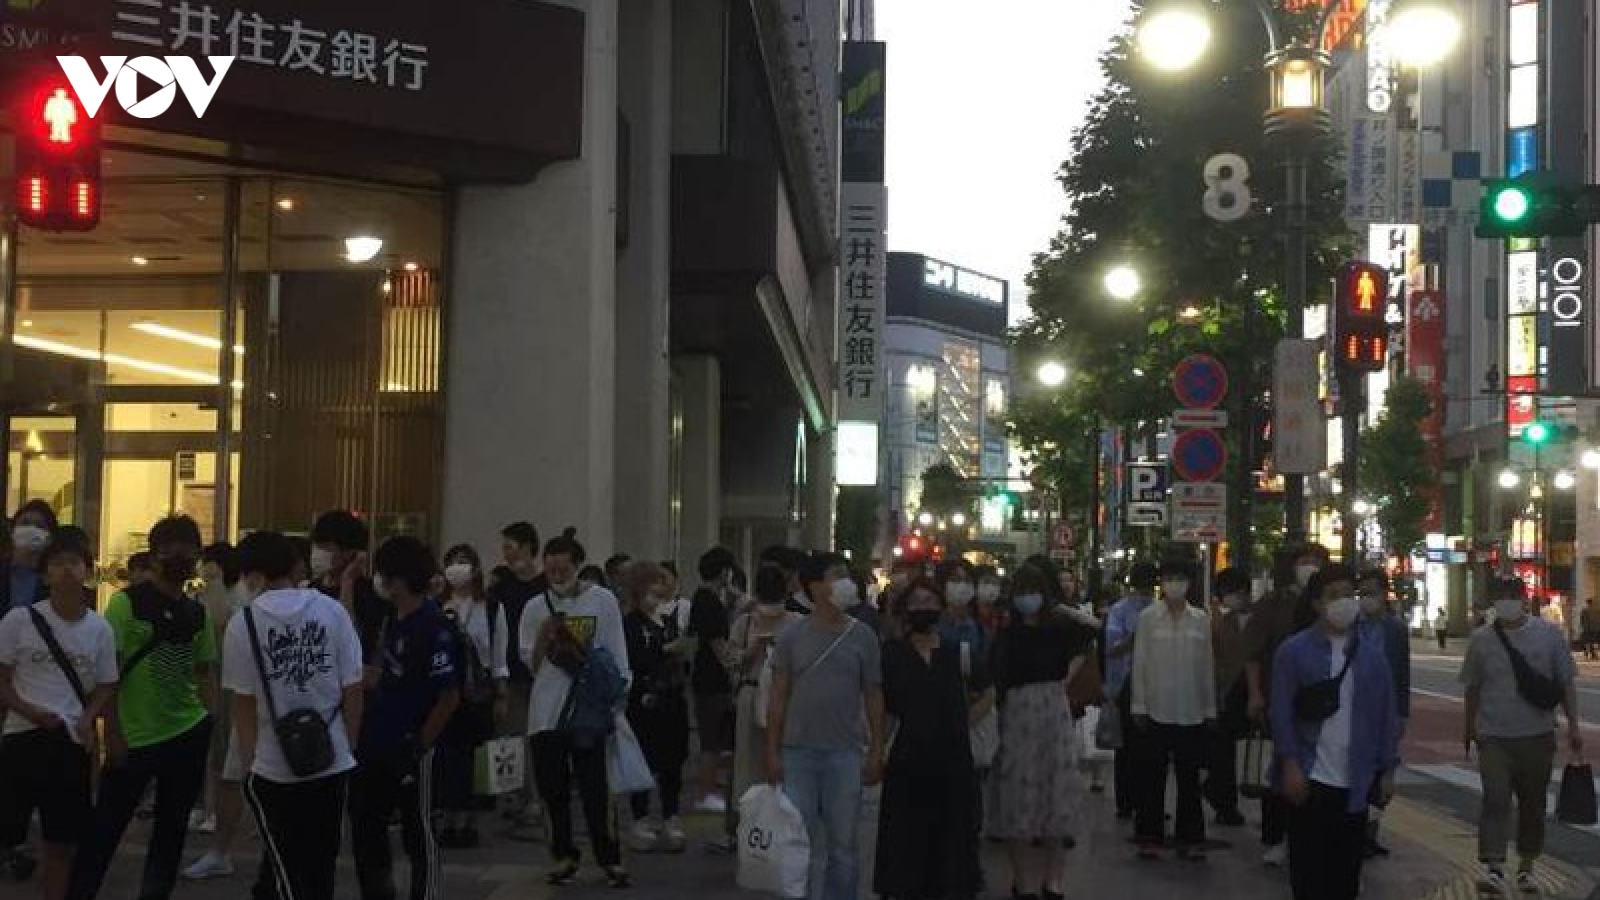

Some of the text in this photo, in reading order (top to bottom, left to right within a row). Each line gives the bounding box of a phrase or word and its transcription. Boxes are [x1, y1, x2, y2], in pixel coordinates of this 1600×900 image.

[111, 0, 428, 90] 三井住友銀行
[1203, 153, 1250, 221] 8
[845, 205, 876, 398] 三井住友銀行
[1131, 467, 1158, 499] P
